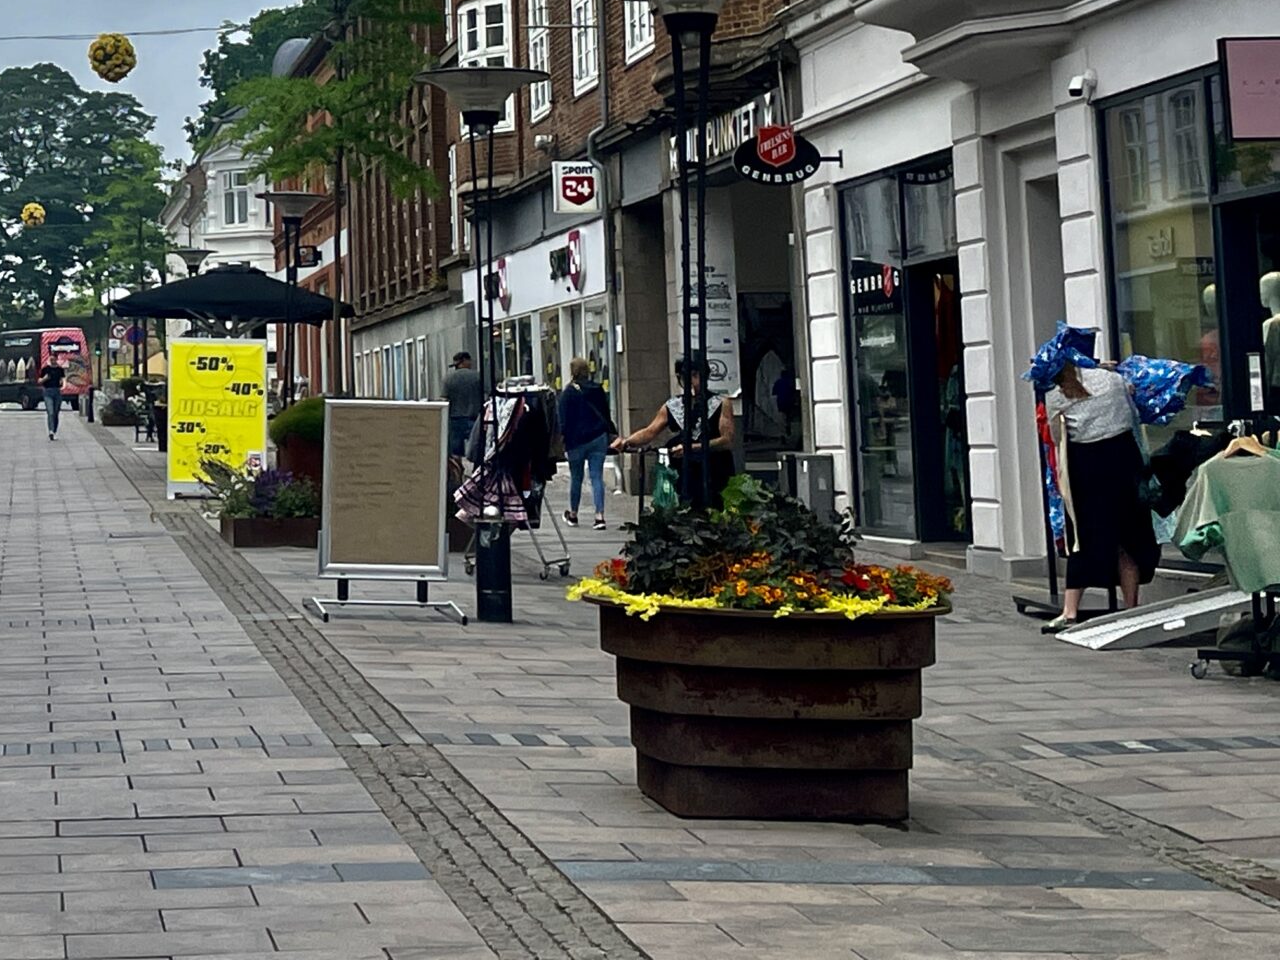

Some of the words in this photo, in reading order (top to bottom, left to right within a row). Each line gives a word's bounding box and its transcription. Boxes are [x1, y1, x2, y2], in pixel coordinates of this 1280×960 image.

[562, 166, 594, 175] SPORT
[741, 164, 816, 183] GENBRUG
[565, 180, 592, 197] 24
[189, 356, 234, 371] -50%
[224, 383, 264, 396] -40%
[179, 399, 258, 418] UDSALG
[171, 422, 206, 433] -30%
[200, 444, 231, 454] -20%
